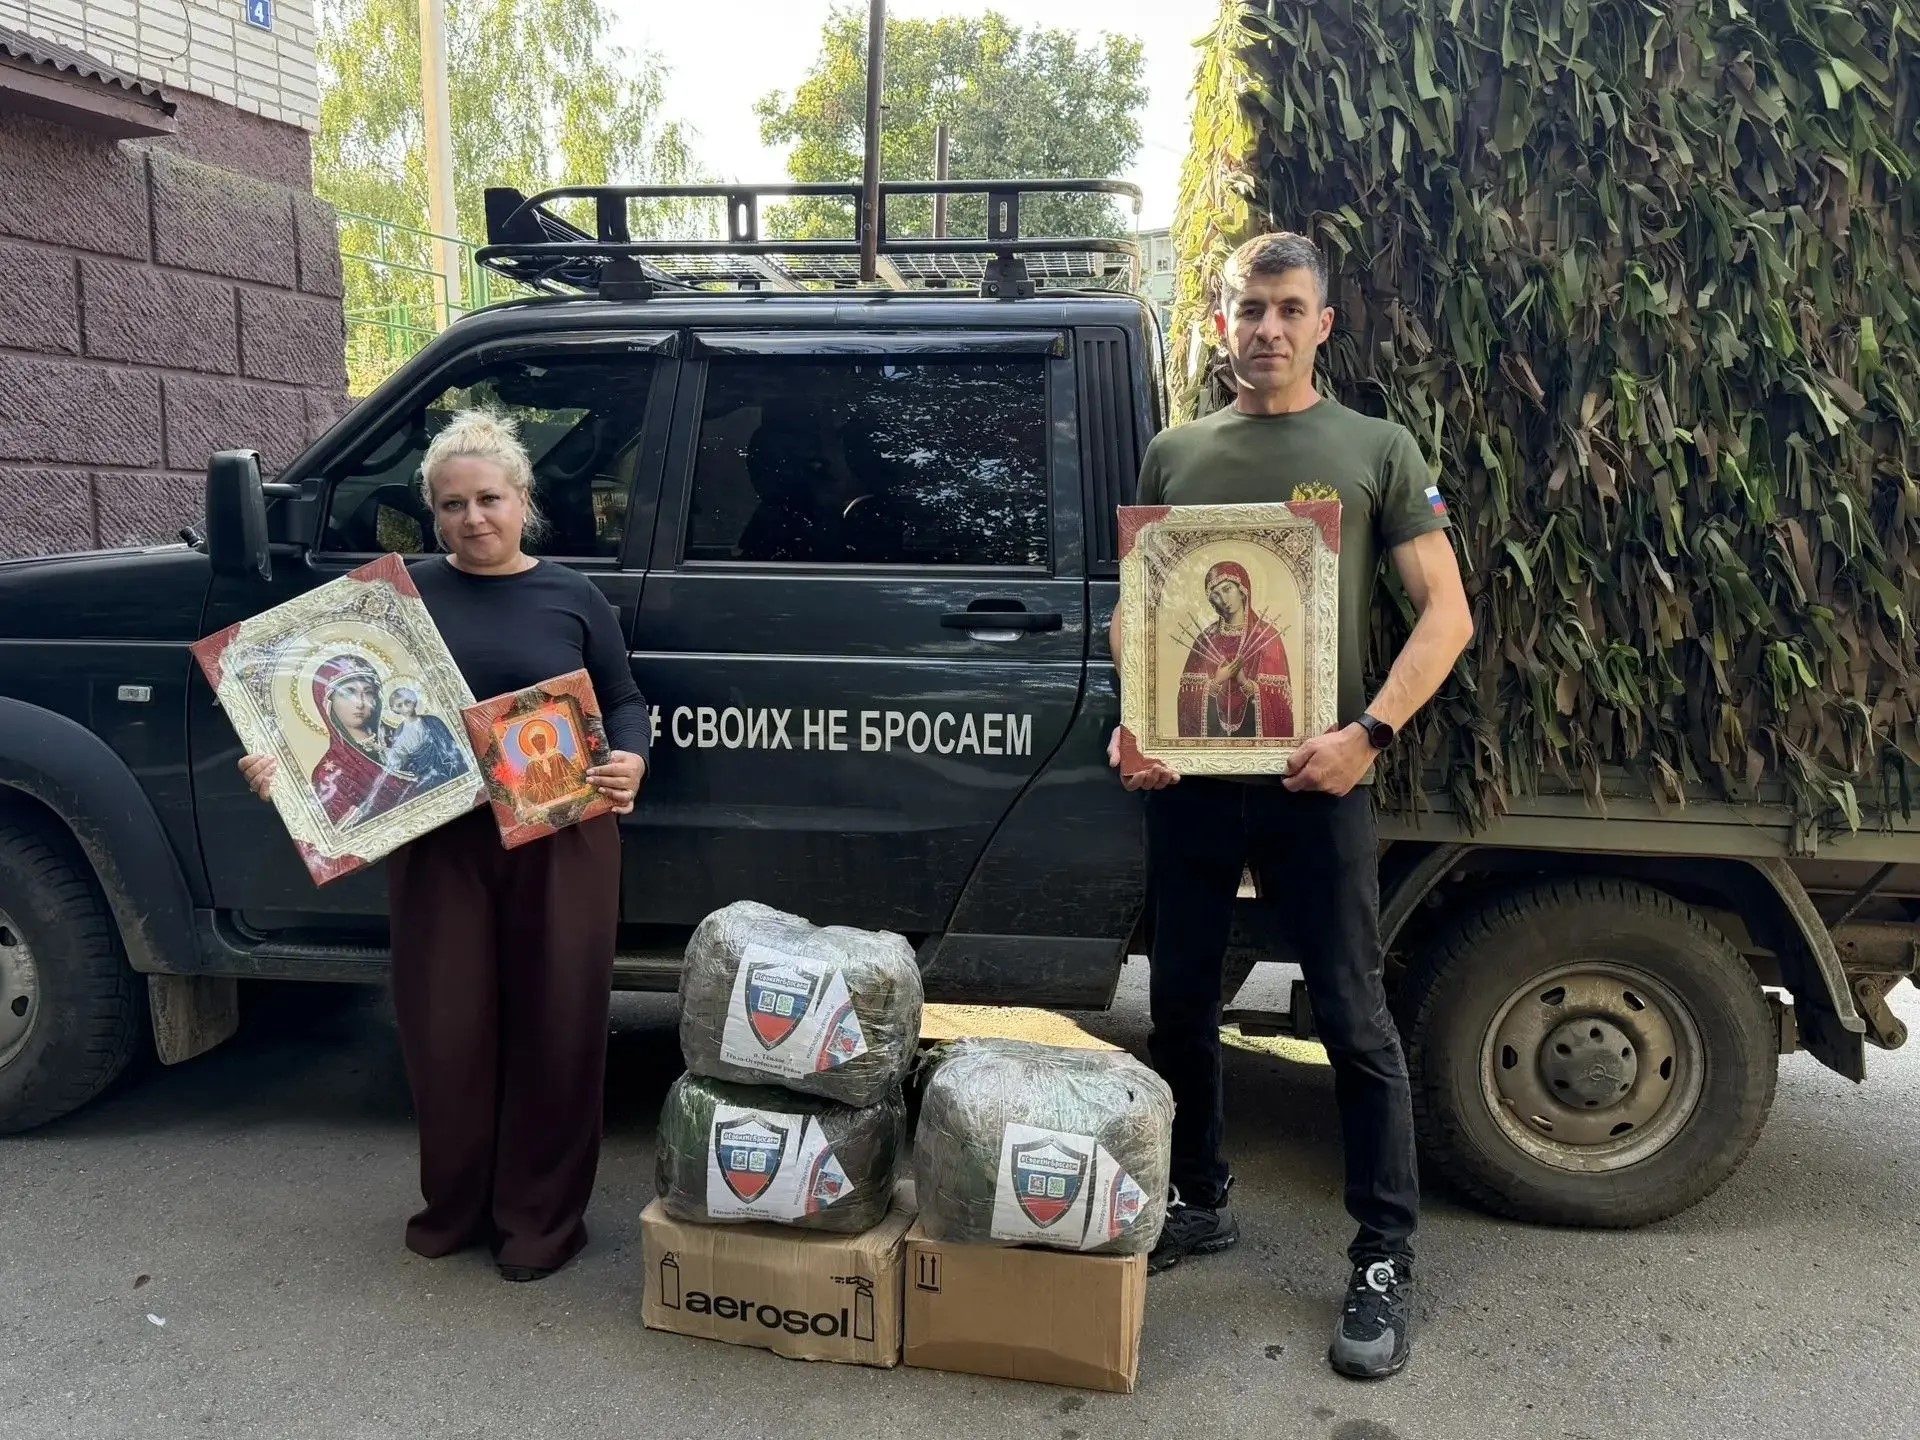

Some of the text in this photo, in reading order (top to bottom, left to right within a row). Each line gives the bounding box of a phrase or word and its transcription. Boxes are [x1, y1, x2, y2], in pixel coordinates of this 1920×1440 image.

[254, 1, 265, 23] 4
[671, 706, 793, 750] СВОИХ
[803, 709, 849, 751] НЕ
[860, 710, 1033, 757] БРОСАЕМ
[685, 1290, 849, 1338] aerosol
